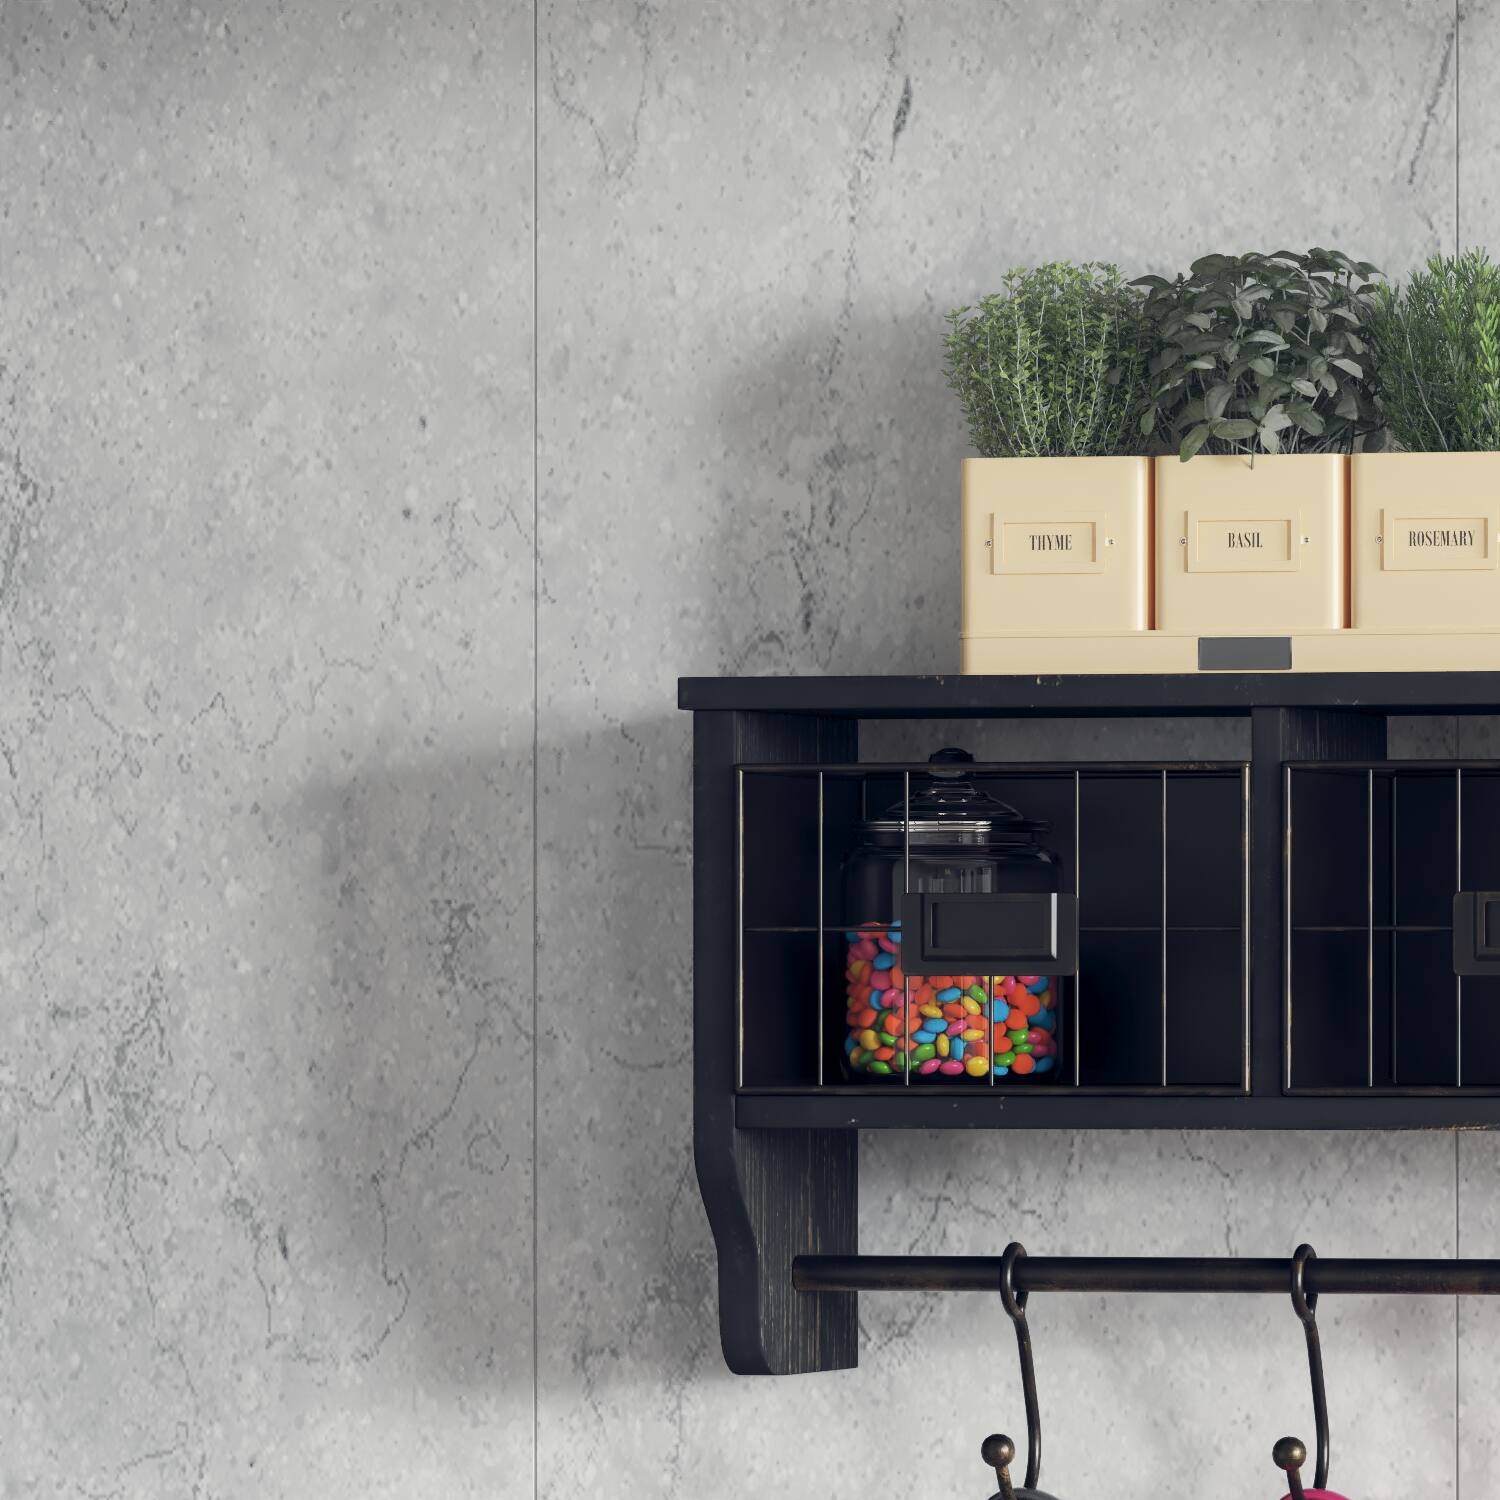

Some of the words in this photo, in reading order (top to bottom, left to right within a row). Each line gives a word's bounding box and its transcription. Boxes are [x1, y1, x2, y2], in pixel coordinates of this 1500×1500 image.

[1029, 534, 1072, 551] THYME
[1228, 532, 1263, 548] BASIL
[1409, 530, 1475, 547] ROSEMARY
